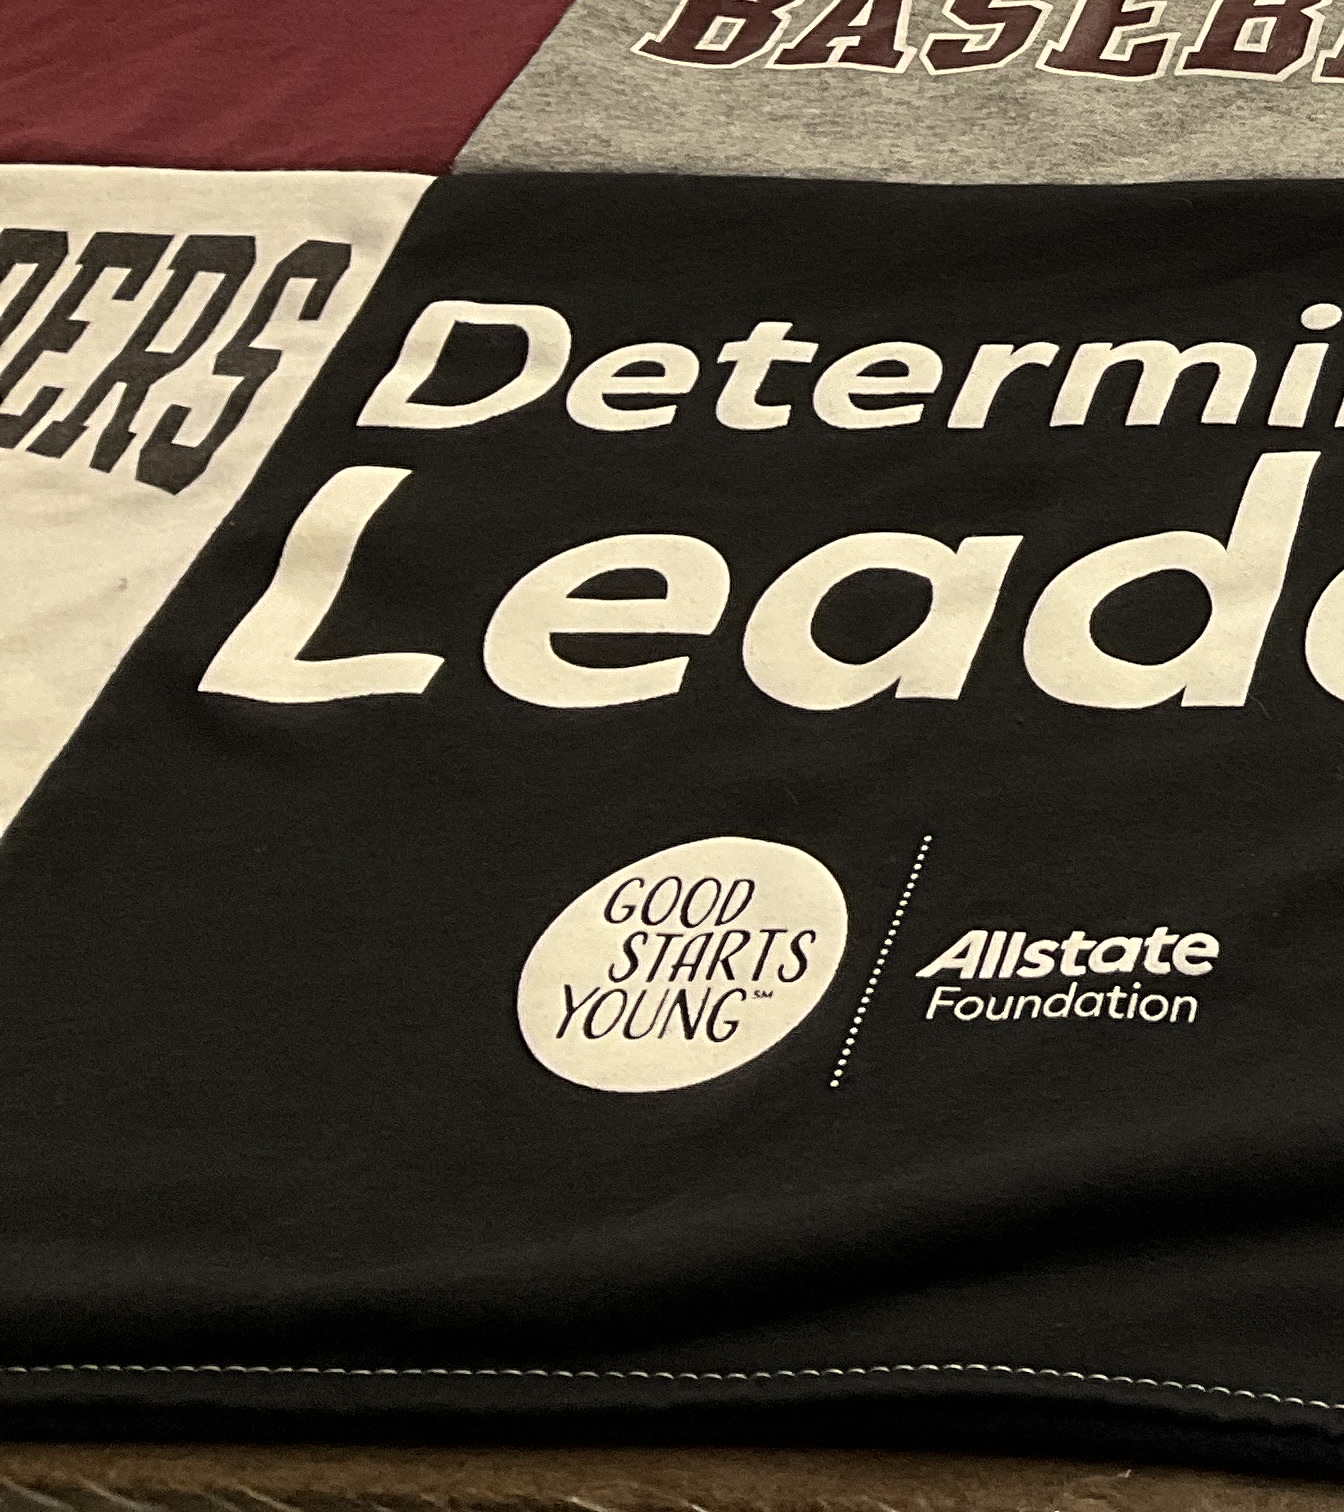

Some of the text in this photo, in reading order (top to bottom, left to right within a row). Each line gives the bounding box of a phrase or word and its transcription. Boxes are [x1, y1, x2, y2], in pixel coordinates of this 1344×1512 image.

[601, 875, 756, 929] GOOD
[608, 927, 817, 984] STARTS
[915, 926, 1220, 980] Allstate
[555, 984, 748, 1044] YOUNG
[925, 981, 1199, 1024] Foundation
